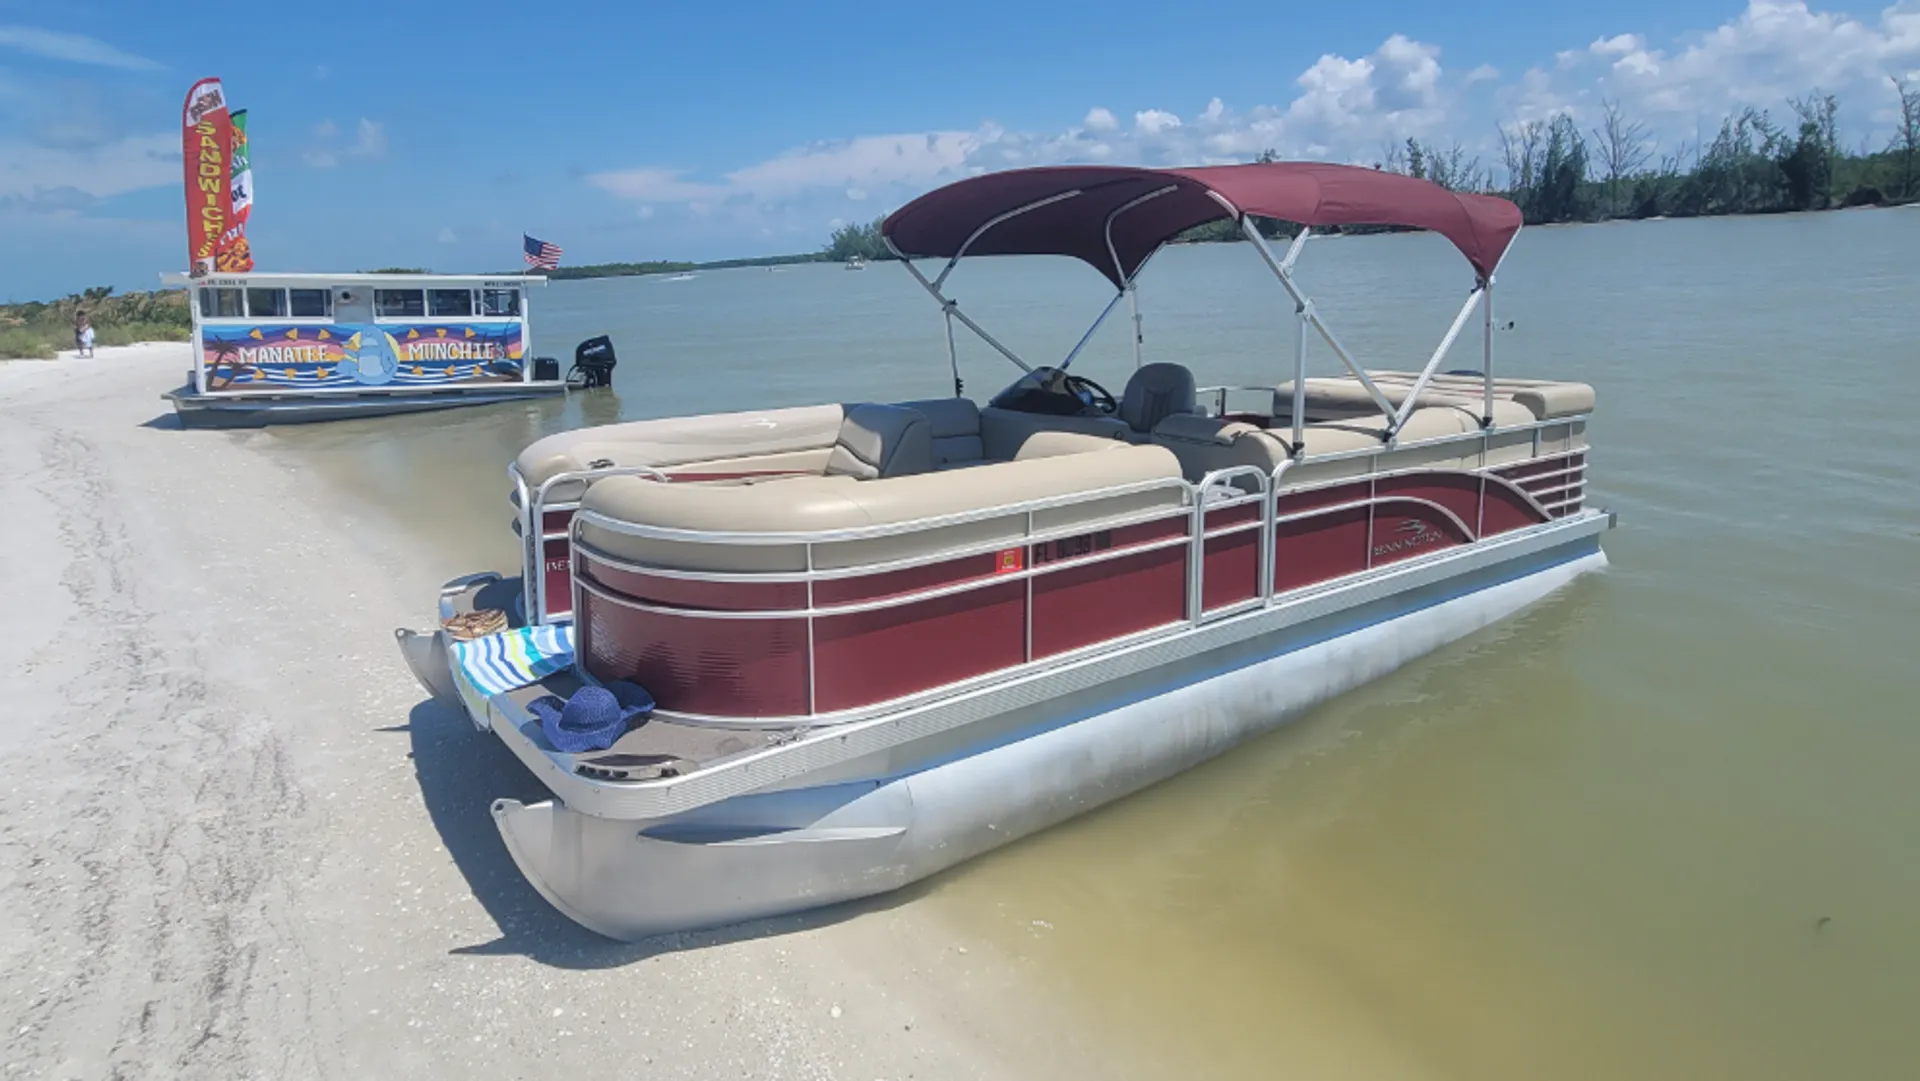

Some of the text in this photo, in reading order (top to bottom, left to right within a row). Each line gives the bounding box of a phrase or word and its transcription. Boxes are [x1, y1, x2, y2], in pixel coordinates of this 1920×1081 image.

[195, 119, 224, 258] SANDWICHES
[237, 342, 506, 364] MANATEE MUNCHIES
